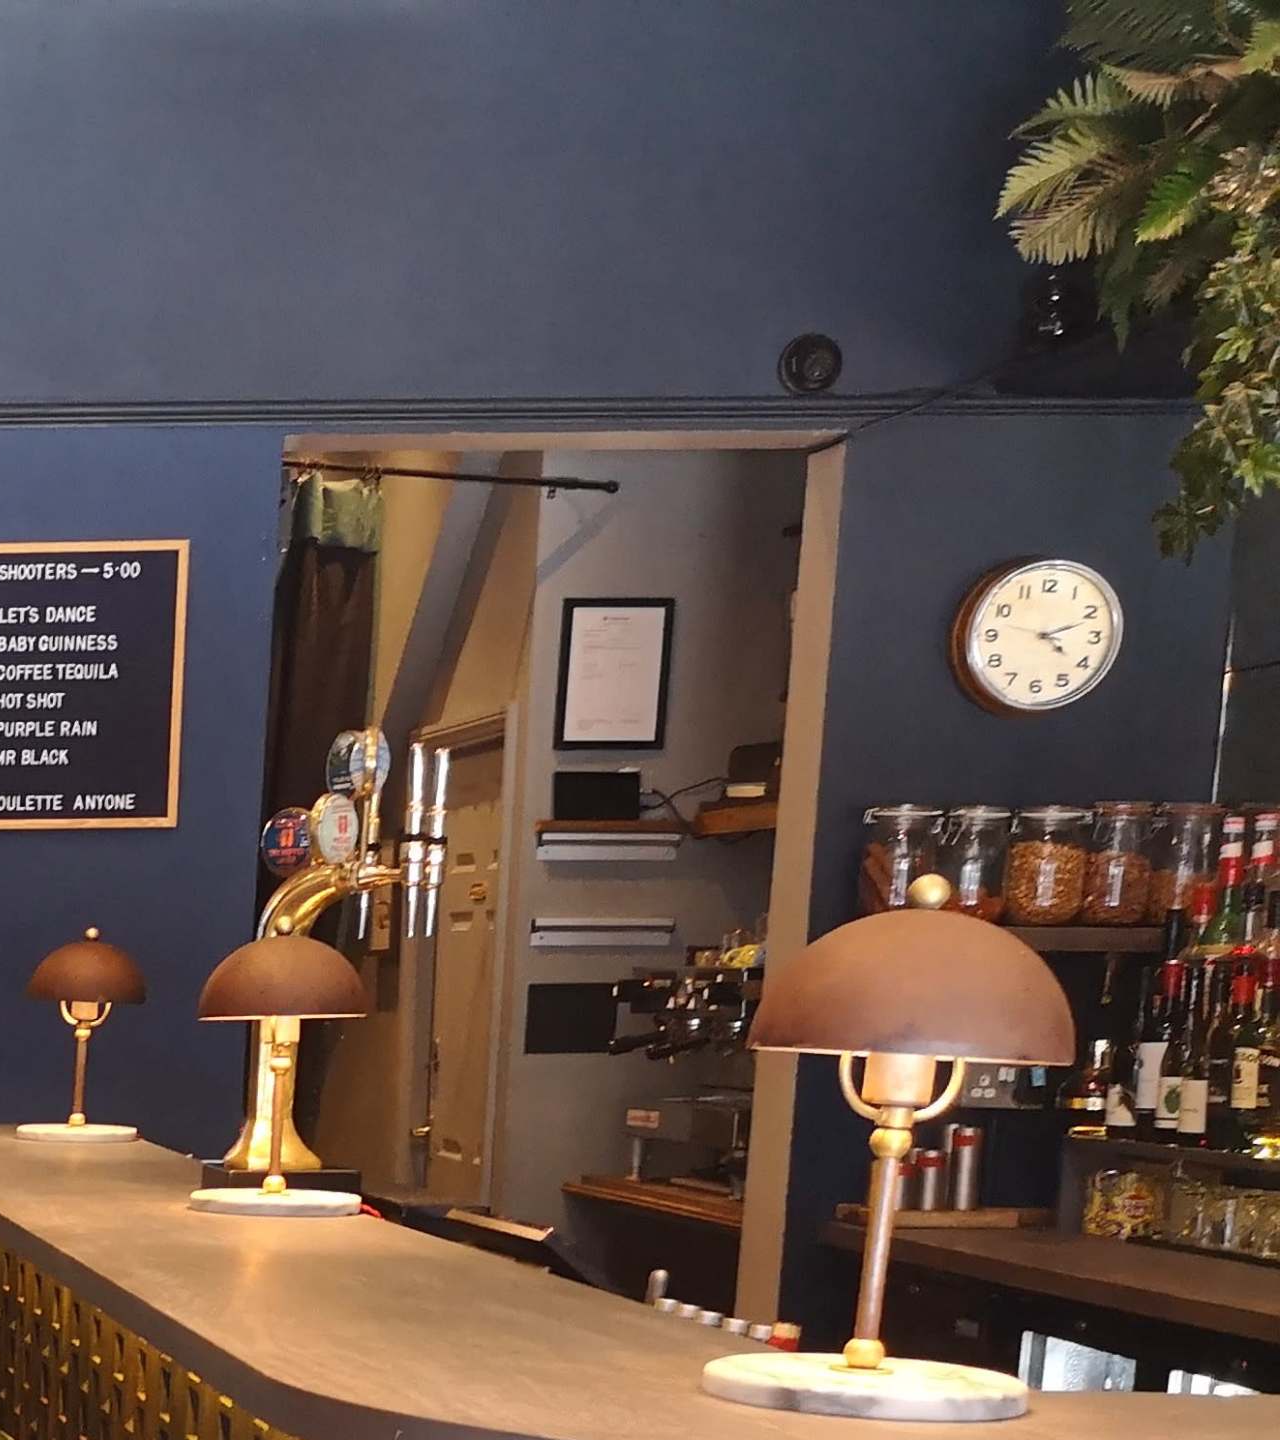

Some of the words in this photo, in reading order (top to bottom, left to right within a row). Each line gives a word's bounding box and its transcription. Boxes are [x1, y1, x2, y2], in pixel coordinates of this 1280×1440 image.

[0, 563, 77, 580] SHOOTERS
[1043, 580, 1057, 592] 12
[46, 606, 96, 623] DANCE
[997, 605, 1011, 617] 10
[1084, 606, 1097, 619] 2
[986, 629, 998, 642] 9
[1089, 631, 1101, 644] 3
[38, 635, 117, 651] GUINNESS
[988, 654, 1001, 668] 8
[1077, 656, 1089, 669] 4
[55, 663, 118, 680] TEQUILA
[1006, 673, 1017, 685] 7
[1056, 674, 1069, 687] 5
[1030, 680, 1041, 693] 6
[26, 693, 65, 709] SHOT
[60, 720, 97, 736] RAIN
[21, 749, 68, 765] BLACK
[73, 794, 135, 810] ANYONE
